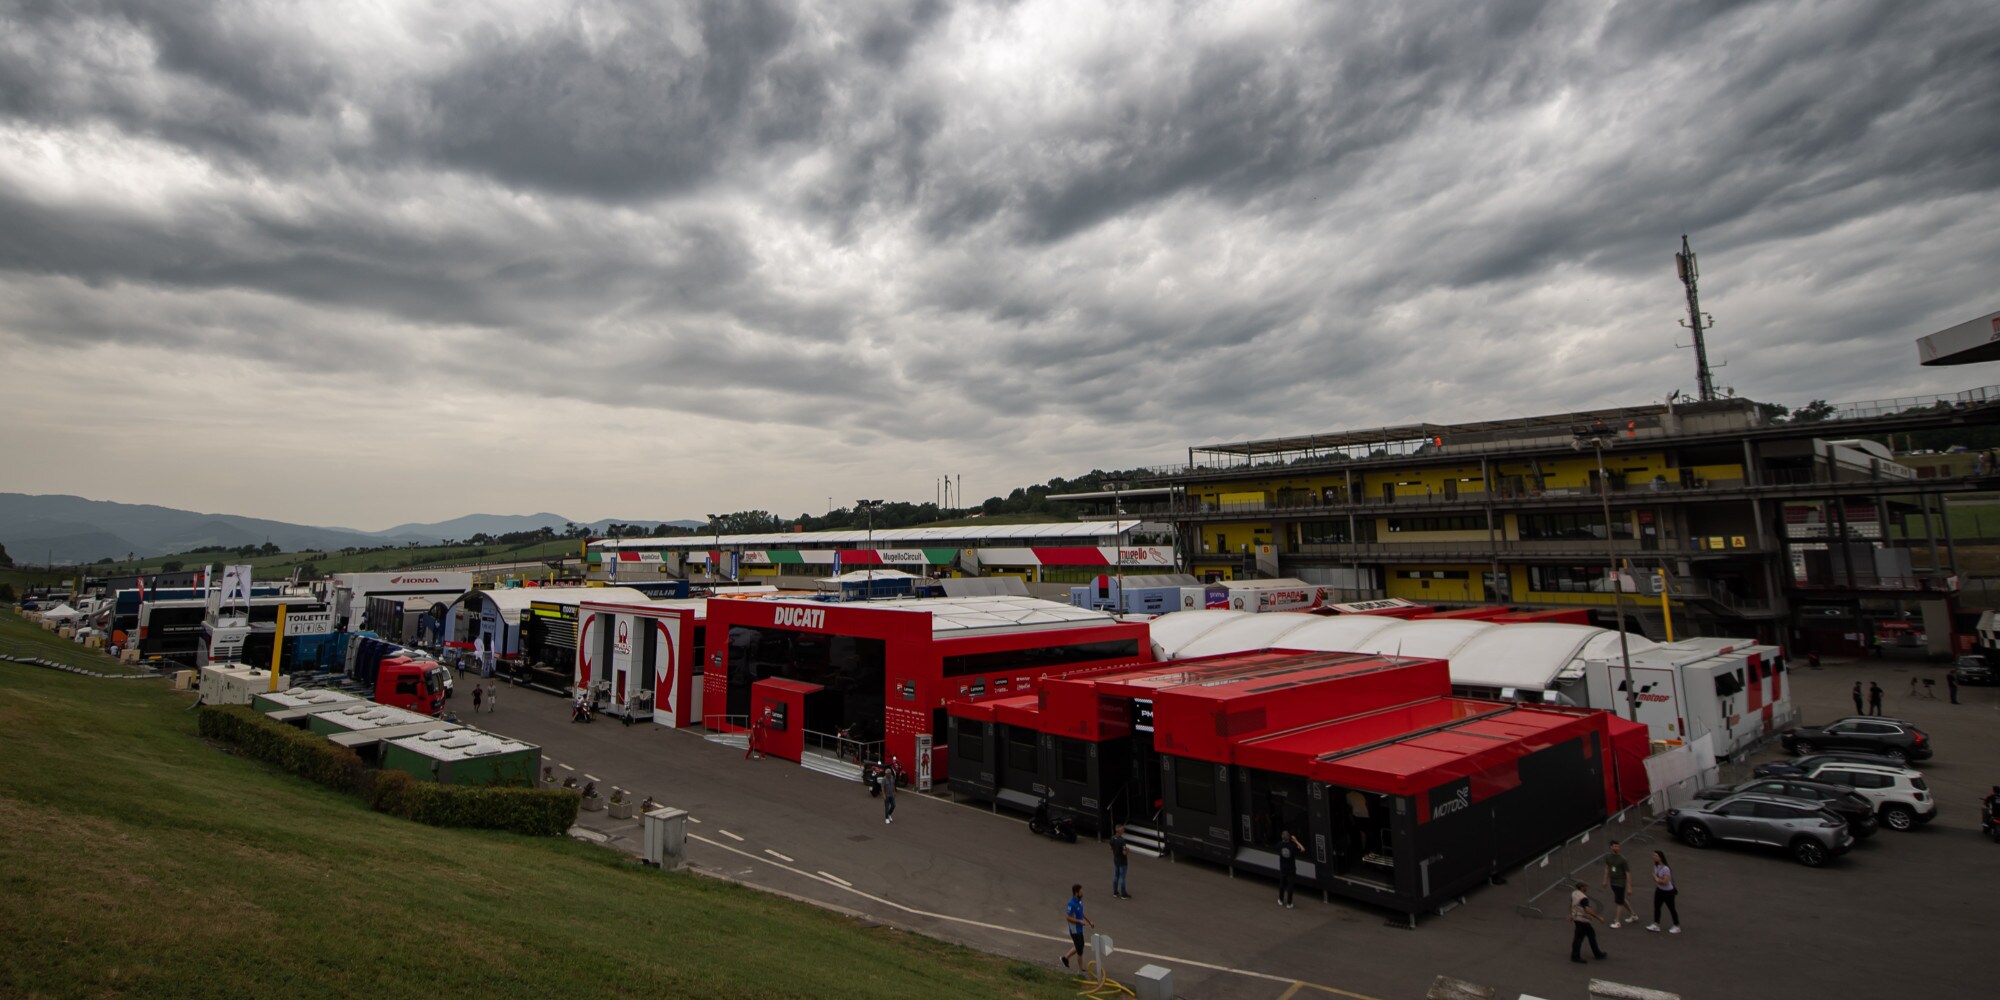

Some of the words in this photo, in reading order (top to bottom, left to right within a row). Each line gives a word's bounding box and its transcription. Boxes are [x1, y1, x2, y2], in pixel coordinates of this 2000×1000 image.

[1734, 537, 1744, 546] A
[883, 552, 922, 562] MugelloCircuit
[1119, 548, 1148, 561] mugello
[288, 614, 331, 622] TOILETTE
[774, 606, 826, 630] DUCATI
